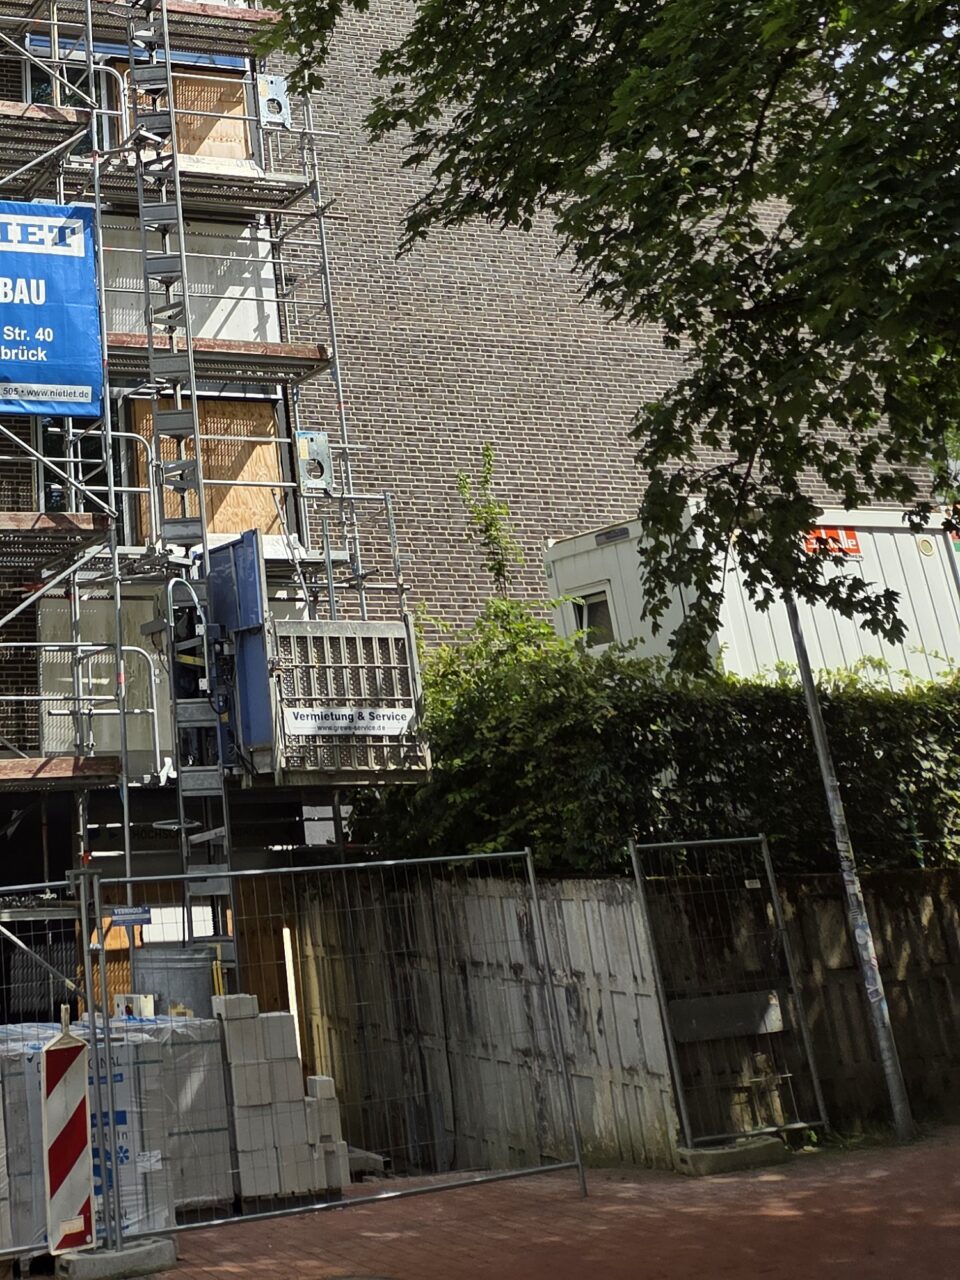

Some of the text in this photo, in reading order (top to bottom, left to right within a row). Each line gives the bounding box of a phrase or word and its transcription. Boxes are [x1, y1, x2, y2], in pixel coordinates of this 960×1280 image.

[3, 325, 30, 341] Str.
[35, 327, 54, 342] 40
[3, 387, 19, 396] 505
[292, 711, 407, 723] Vermietung & Service
